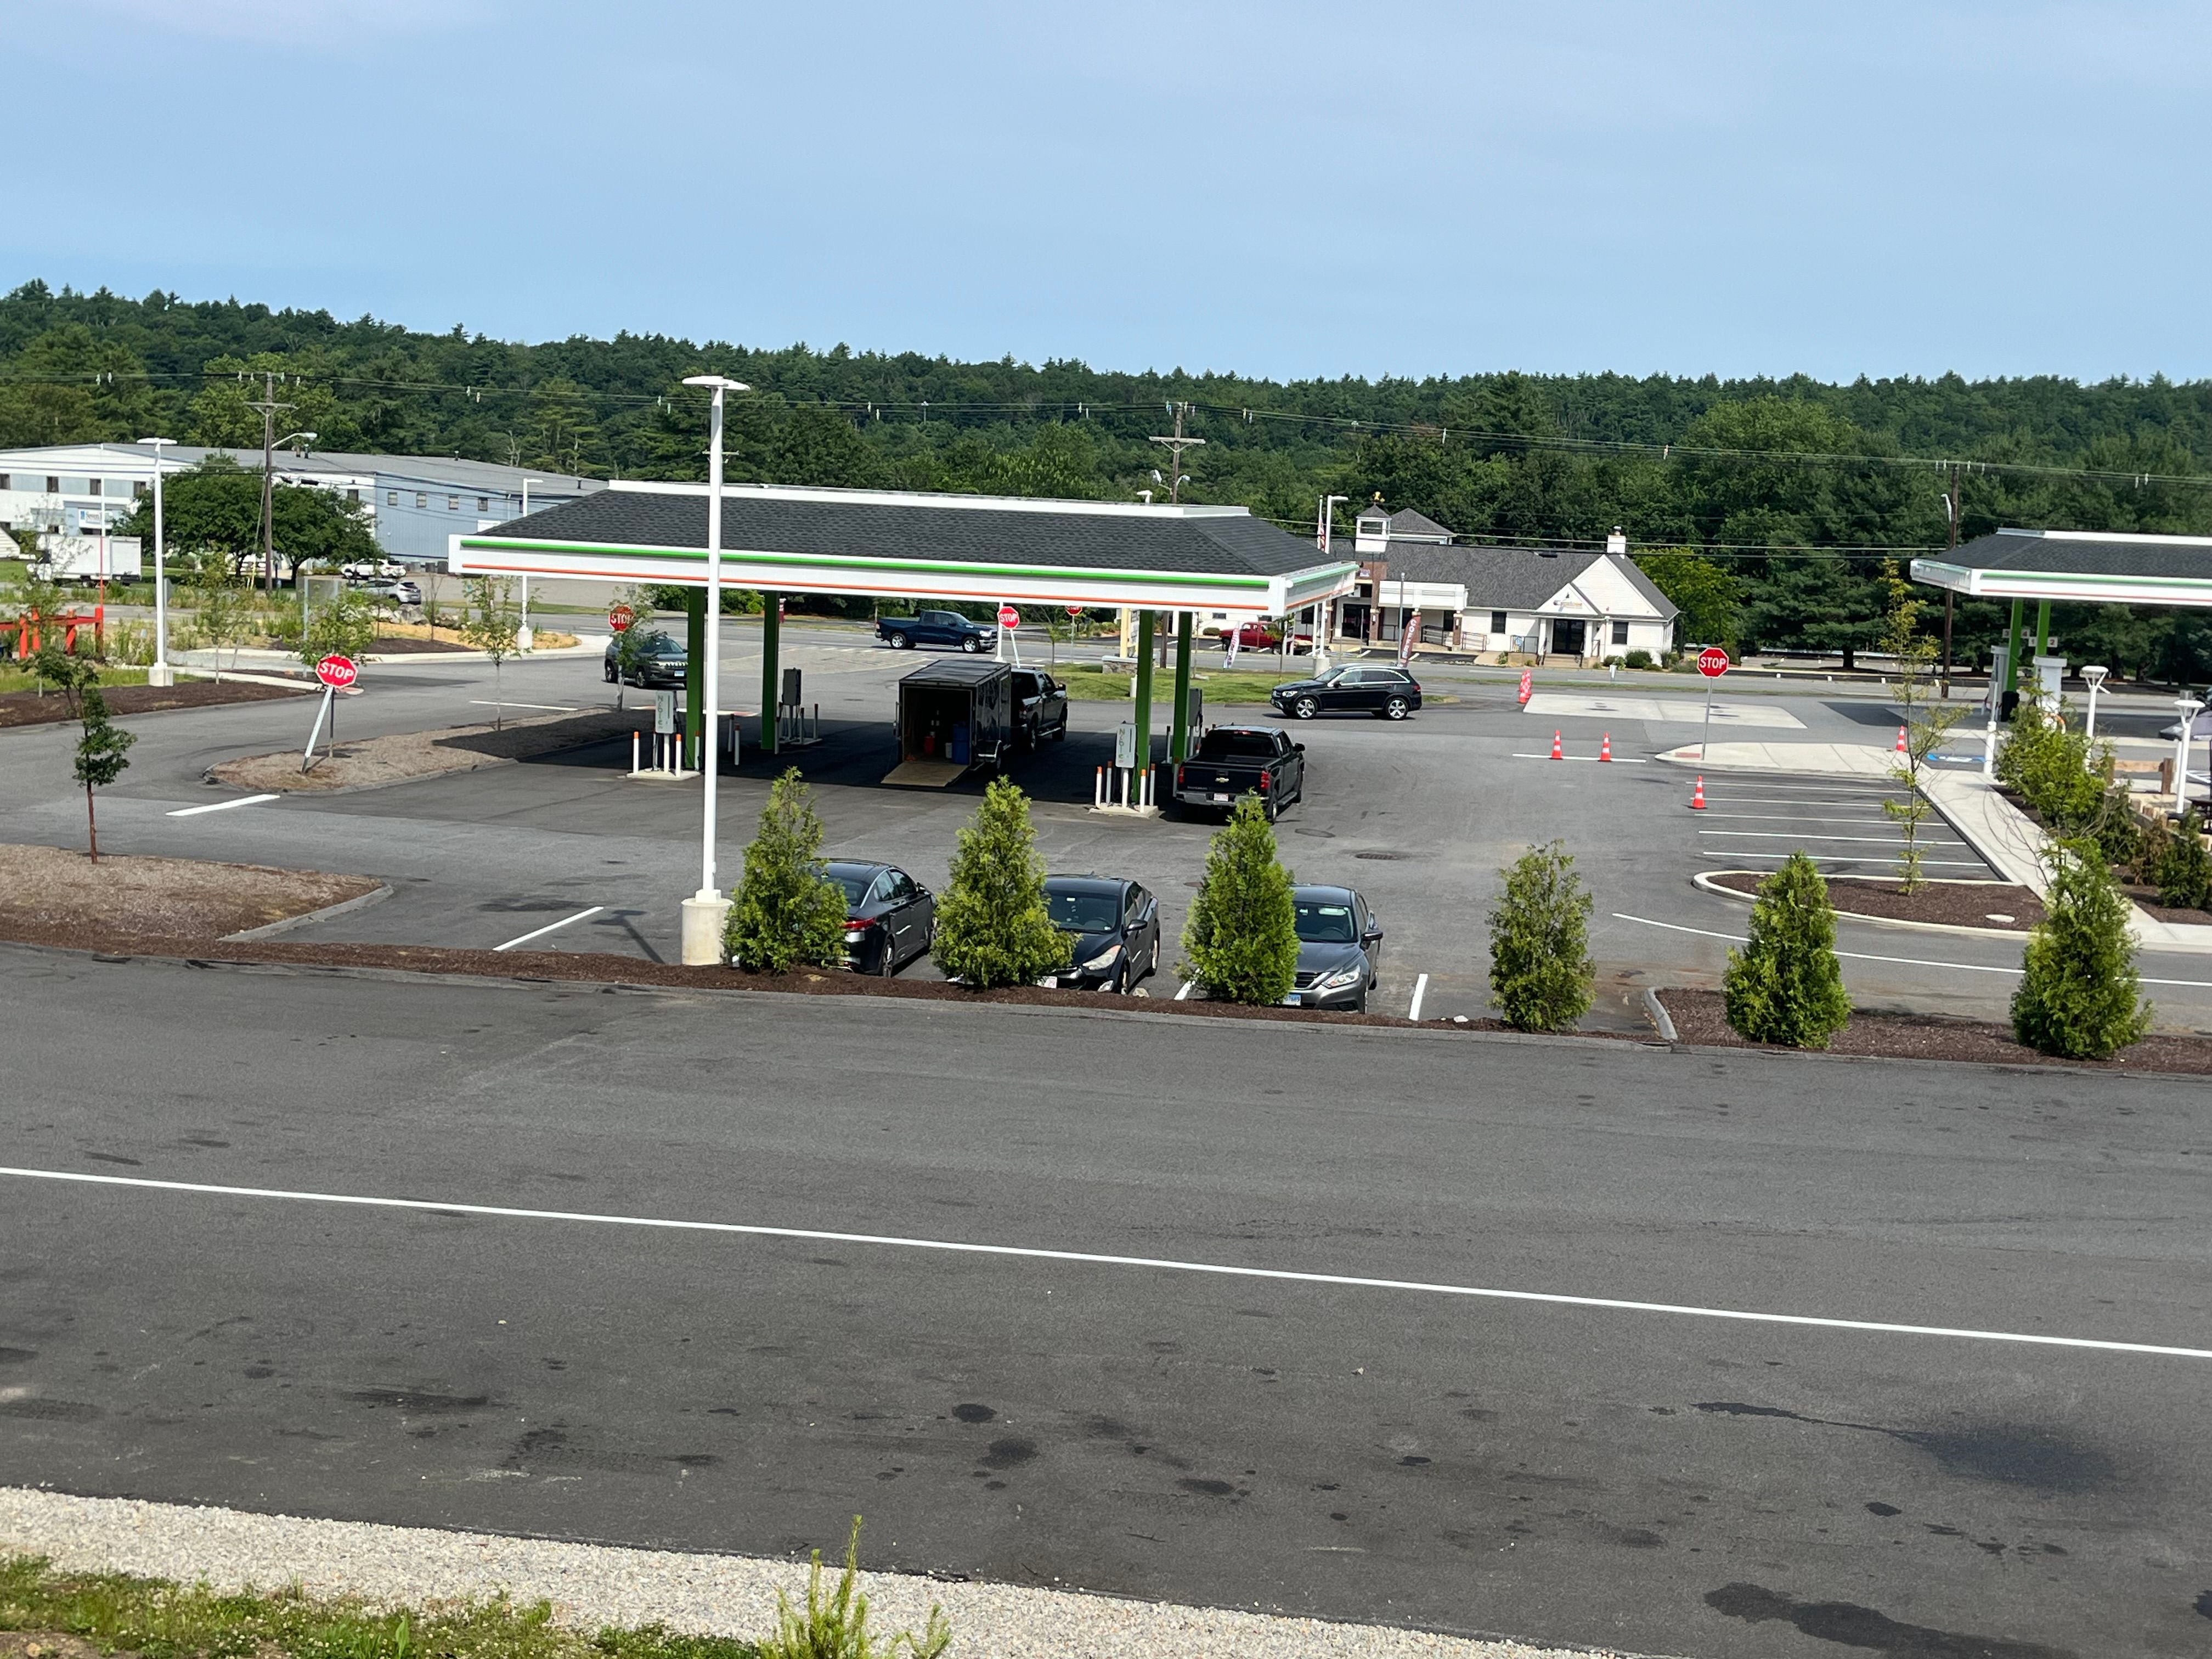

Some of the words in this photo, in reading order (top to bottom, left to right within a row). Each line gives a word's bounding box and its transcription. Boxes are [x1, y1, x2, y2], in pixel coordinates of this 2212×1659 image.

[1000, 613, 1018, 623] STOP
[1700, 657, 1726, 669] STOP
[319, 662, 354, 680] STOP
